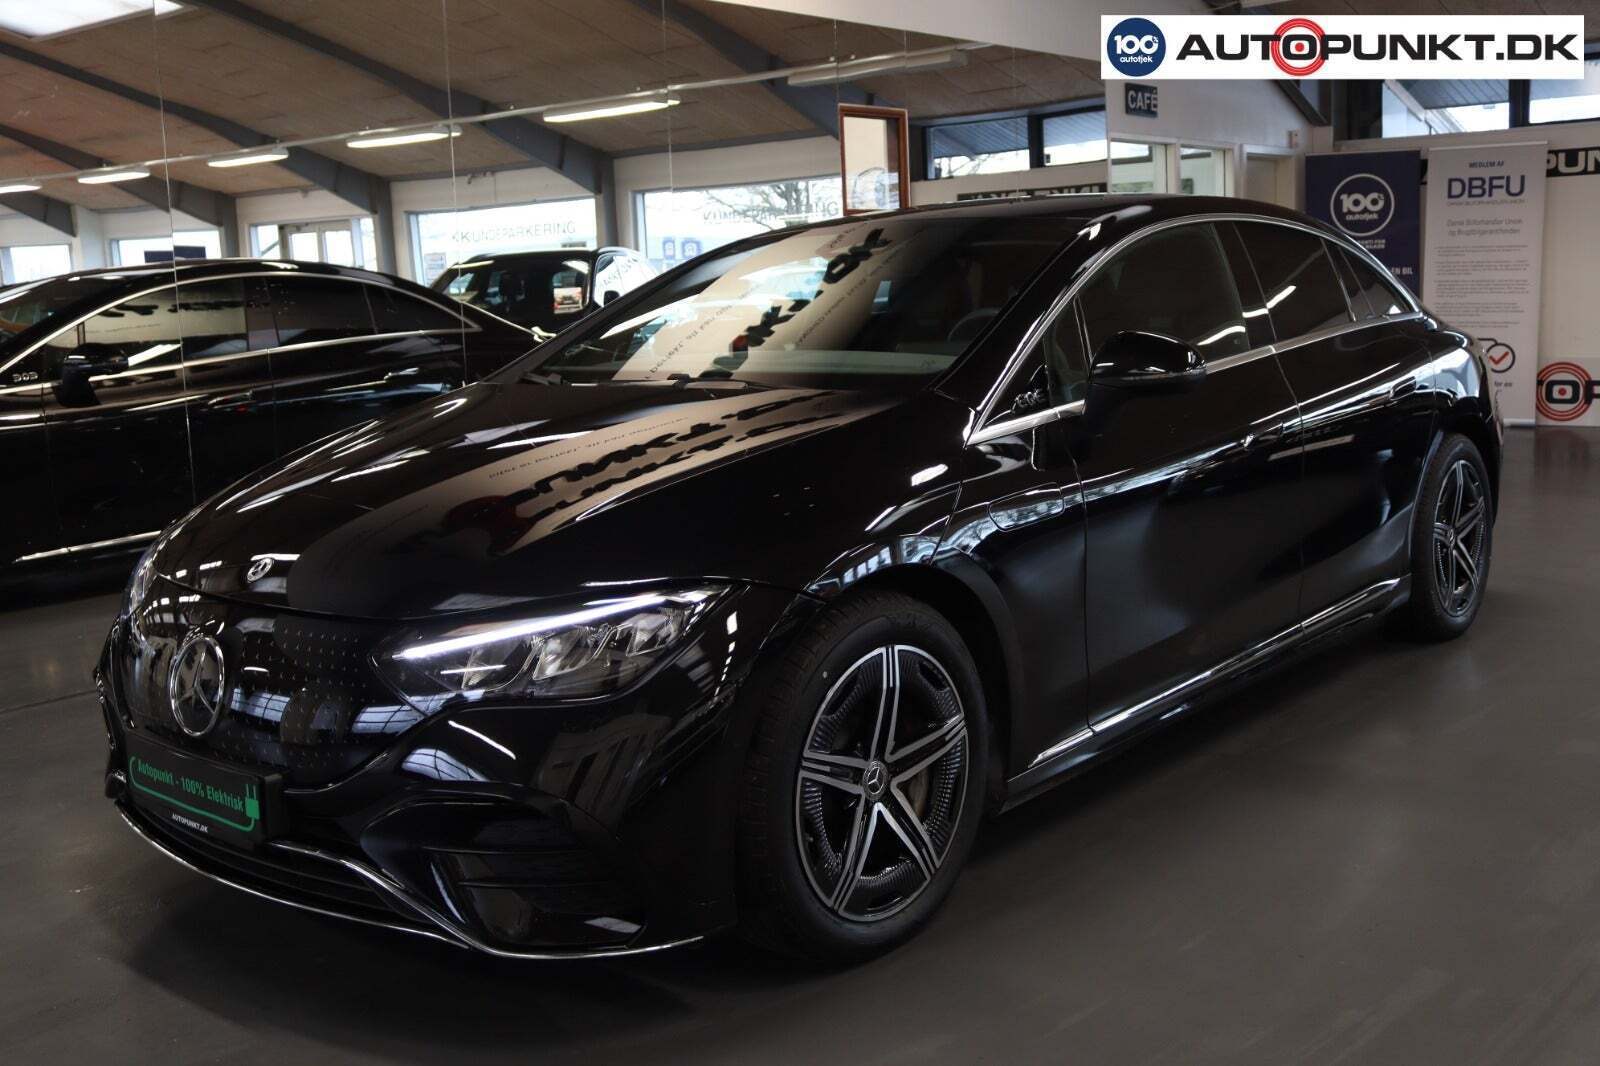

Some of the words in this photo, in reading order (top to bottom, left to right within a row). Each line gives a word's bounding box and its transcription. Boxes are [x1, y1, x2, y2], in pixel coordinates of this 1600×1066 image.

[1446, 174, 1526, 199] DBFU
[138, 759, 174, 785] Autopunkt
[206, 785, 244, 812] Elektrisk
